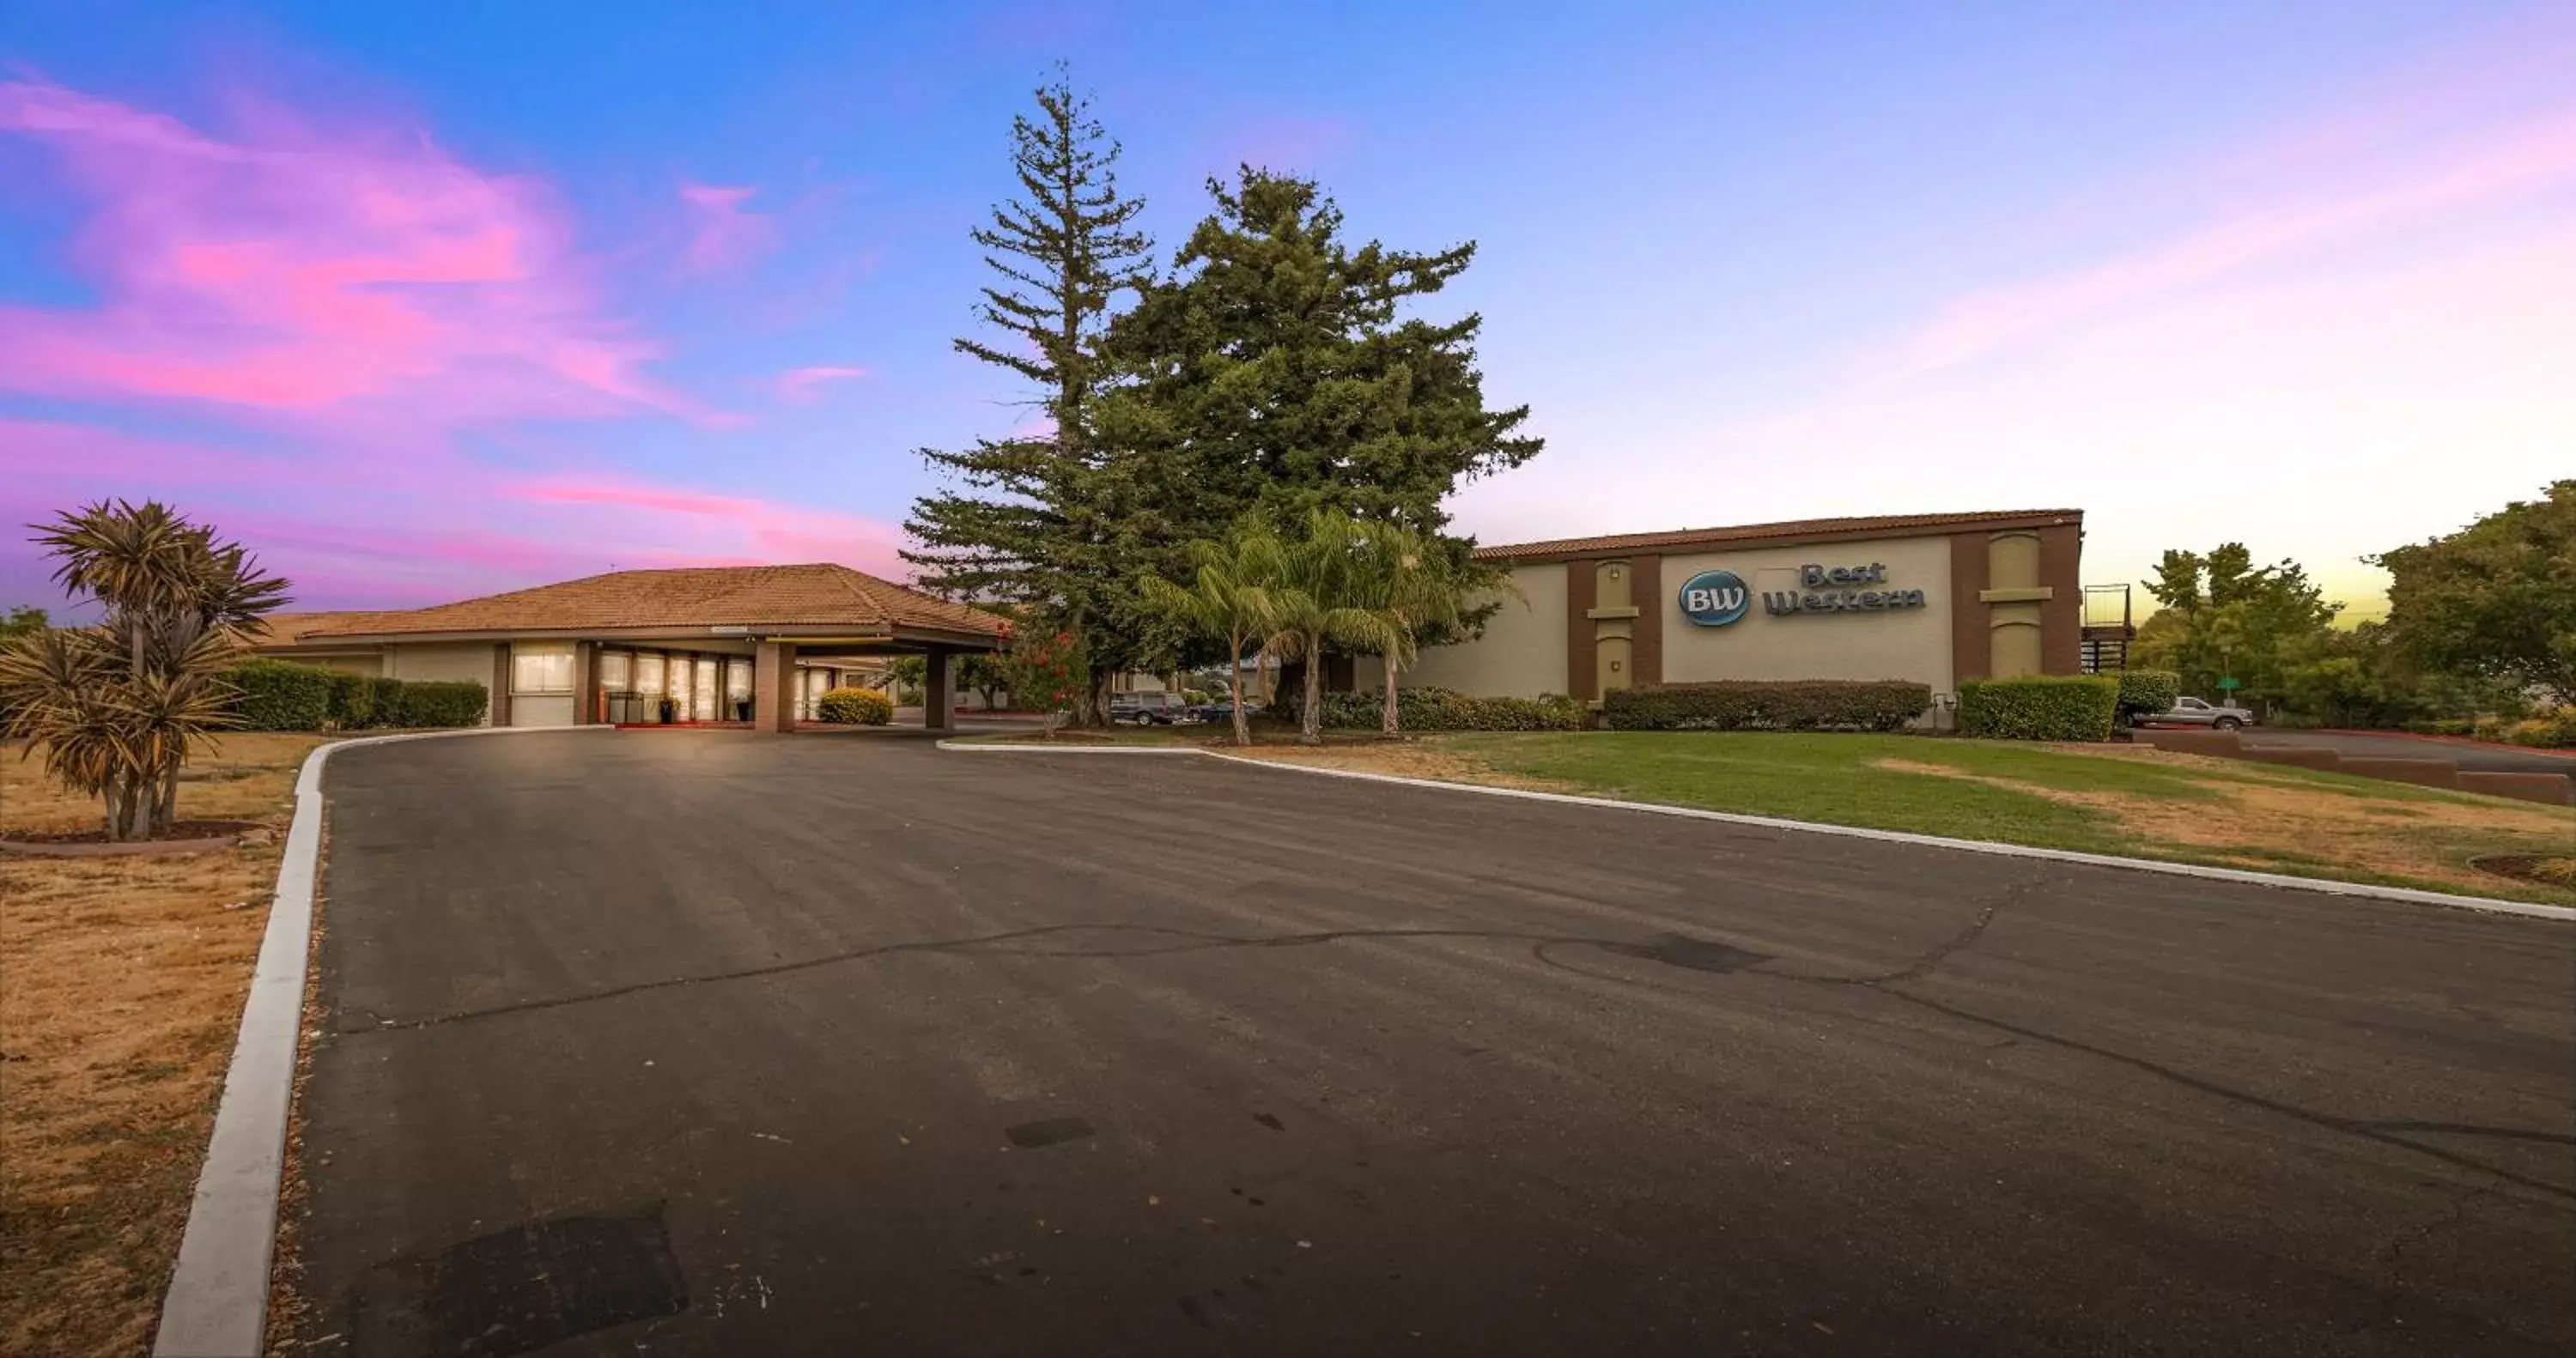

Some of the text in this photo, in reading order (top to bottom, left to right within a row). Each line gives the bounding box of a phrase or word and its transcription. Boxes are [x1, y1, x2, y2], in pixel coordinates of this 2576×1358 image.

[1801, 562, 1886, 587] Best
[1687, 587, 1744, 612] BW
[1762, 588, 1926, 615] Western
